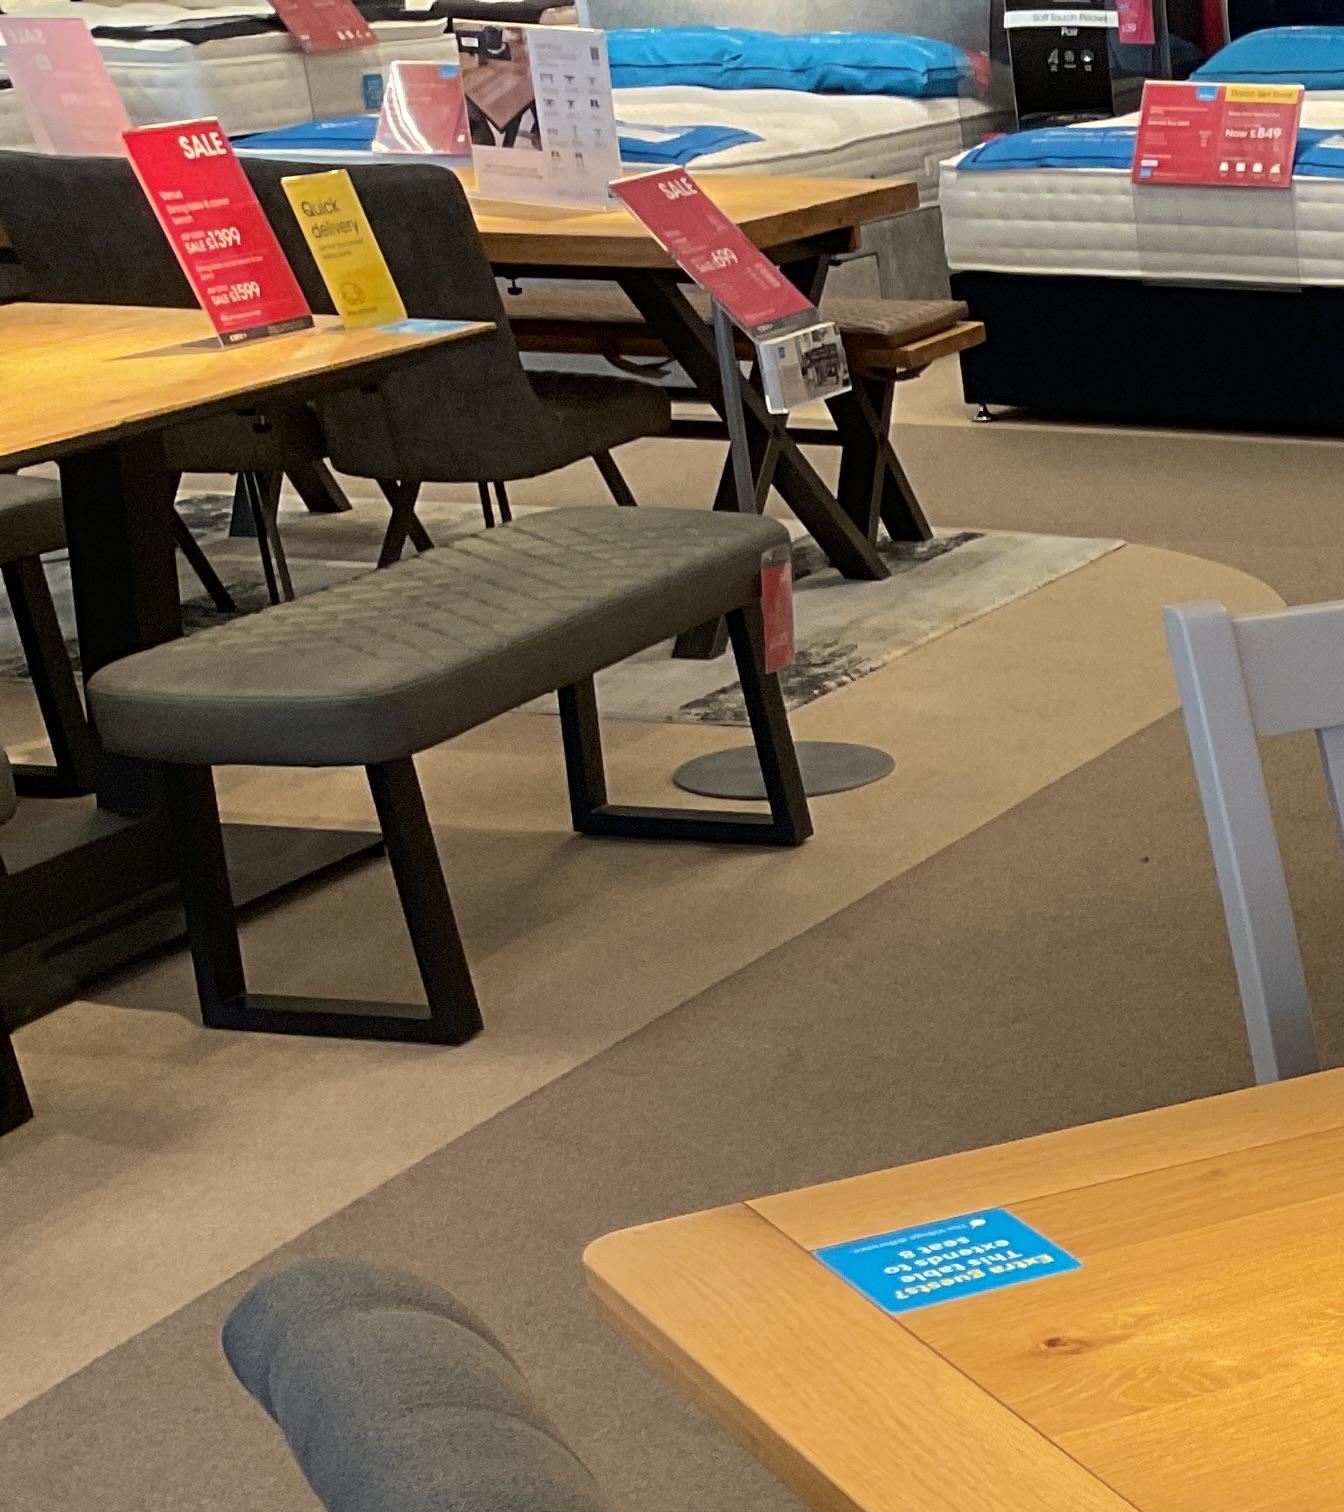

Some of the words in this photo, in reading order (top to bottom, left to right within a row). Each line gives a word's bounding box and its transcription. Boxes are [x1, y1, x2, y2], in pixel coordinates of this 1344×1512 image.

[1225, 128, 1248, 138] Now
[1249, 126, 1282, 140] £849
[178, 131, 228, 160] SALE
[658, 177, 698, 200] SALE
[301, 198, 340, 217] Quick
[311, 219, 361, 239] delivery
[185, 240, 208, 254] SALE
[205, 226, 241, 251] £1399
[229, 281, 261, 304] £1599
[898, 1250, 916, 1259] 8
[914, 1239, 1010, 1267] extends
[917, 1236, 970, 1255] seat
[967, 1250, 1023, 1267] This
[989, 1254, 1054, 1274] Extra
[884, 1264, 913, 1275] to
[900, 1263, 966, 1283] table
[895, 1269, 986, 1300] guests?
